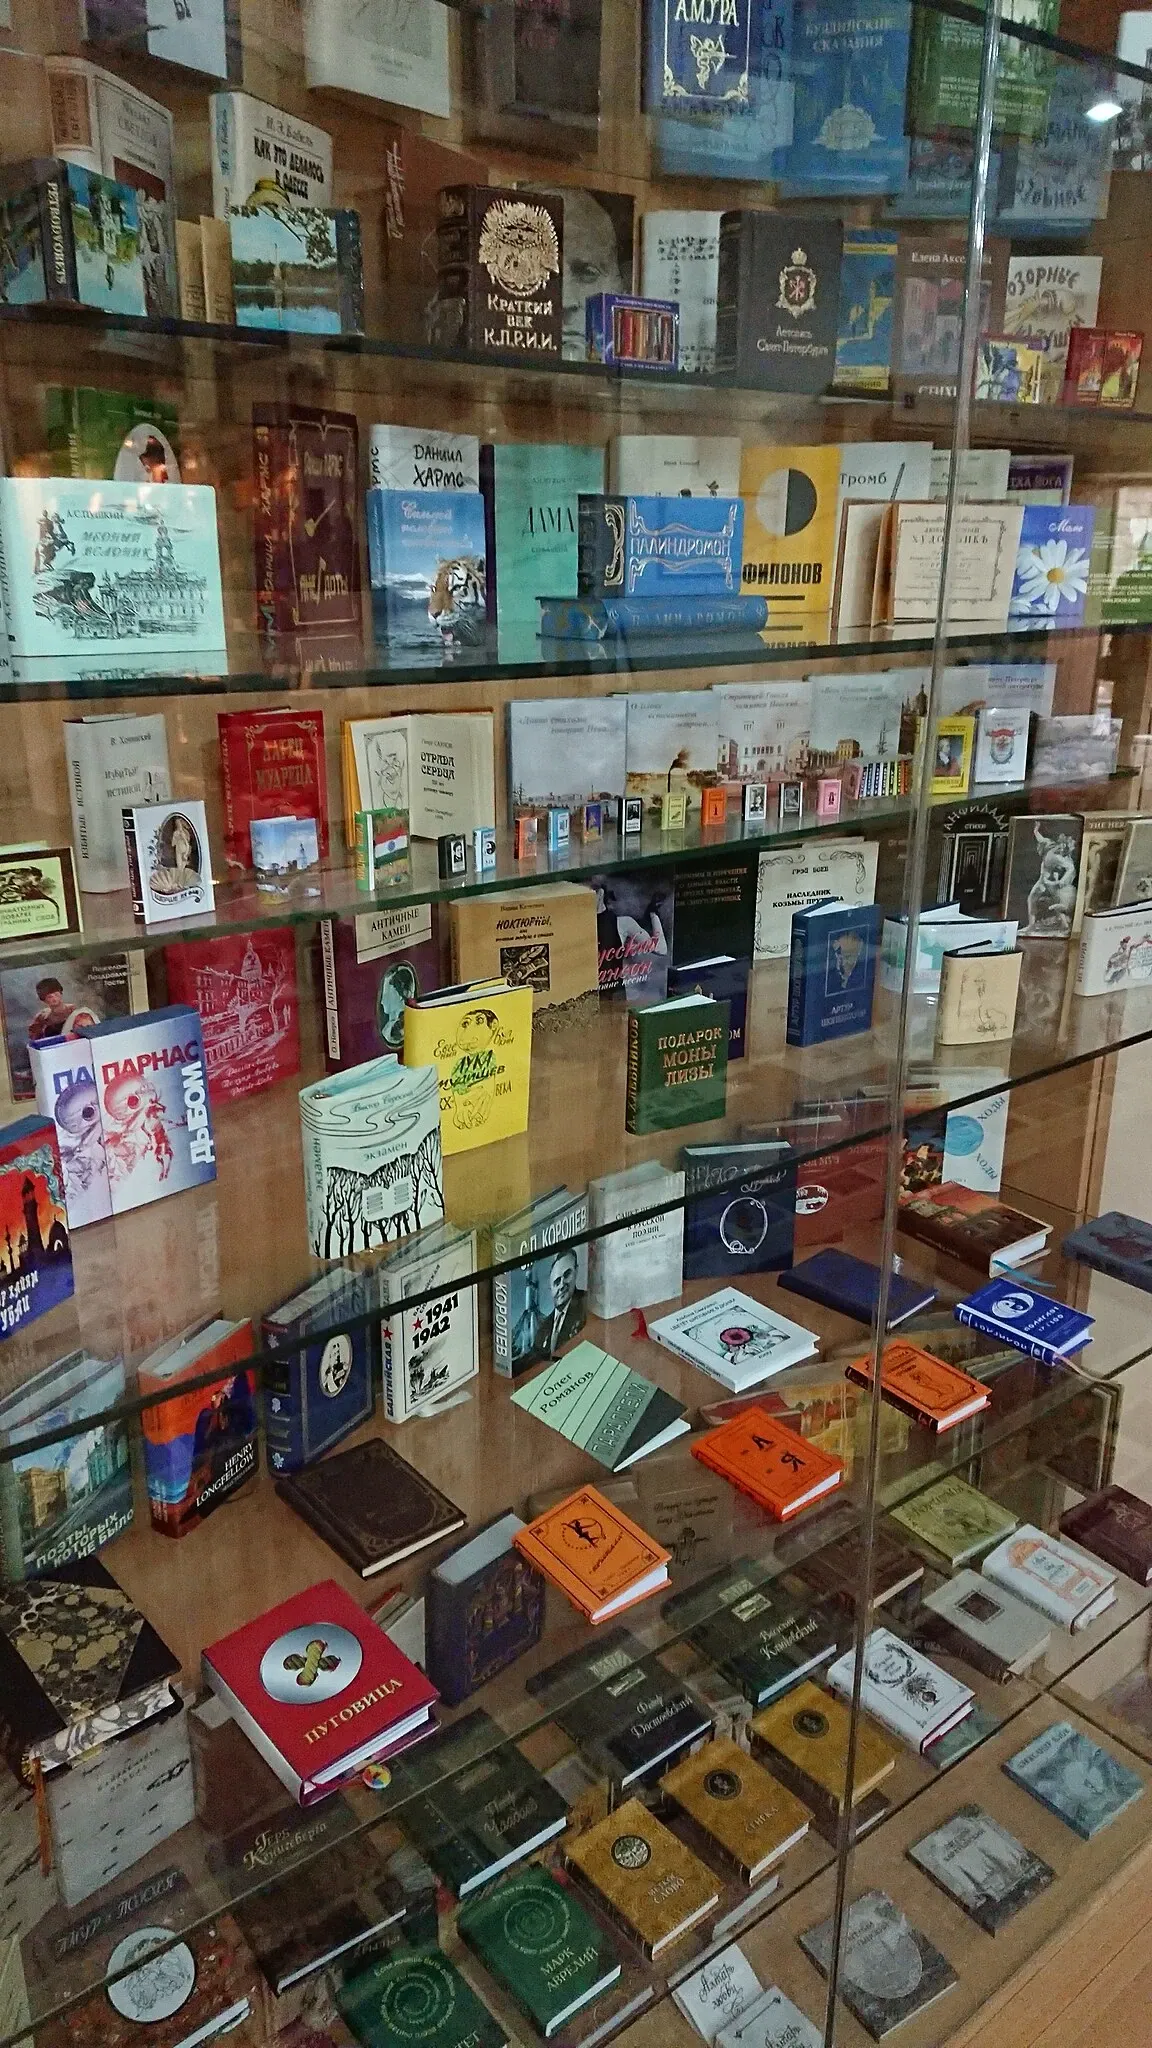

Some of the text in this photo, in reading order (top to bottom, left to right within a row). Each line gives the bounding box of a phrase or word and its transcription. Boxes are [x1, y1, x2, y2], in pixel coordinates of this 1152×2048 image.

[674, 0, 740, 27] АМУРА
[48, 183, 67, 285] PETRODVORETS
[912, 251, 941, 264] Елена
[412, 466, 465, 489] ХАРМС
[839, 472, 888, 487] Тромб
[521, 505, 576, 540] ДАМА
[911, 536, 989, 547] ХУДОНИКЪ
[742, 562, 823, 585] ФИЛОНОВ
[420, 751, 456, 768] ОТРАДА
[420, 764, 456, 782] СЕРДЦА
[786, 888, 832, 899] НАСЛЕДНИК
[370, 907, 420, 933] АНТИЧНЫЕ
[597, 930, 660, 970] усский
[831, 1002, 854, 1016] АРТУР
[658, 1027, 722, 1051] ПОДАРОК
[102, 1040, 201, 1086] ПАРНАС
[662, 1046, 716, 1070] МОНЫ
[664, 1064, 714, 1087] ЛИЗЫ
[540, 1208, 589, 1249] КОРОЛЕВ
[0, 1294, 31, 1334] УБАИ
[425, 1292, 460, 1326] 1941
[494, 1282, 510, 1358] КОРОЛЕВ
[411, 1316, 451, 1352] 1942
[384, 1341, 395, 1417] БАЛТИЙСКАЯ
[539, 1369, 594, 1414] Романов
[542, 1371, 573, 1401] Олег
[223, 1440, 254, 1472] HENRY
[195, 1450, 255, 1509] LONGFELLOW
[53, 1510, 119, 1569] КОТОРЫХ
[77, 1507, 135, 1560] НЕ БЫЛО
[302, 1678, 403, 1746] ПУГОВИЦА
[652, 1876, 686, 1905] СЛОВО
[540, 1947, 575, 1977] МАРК
[546, 1946, 599, 1993] АВРЕЛИЙ
